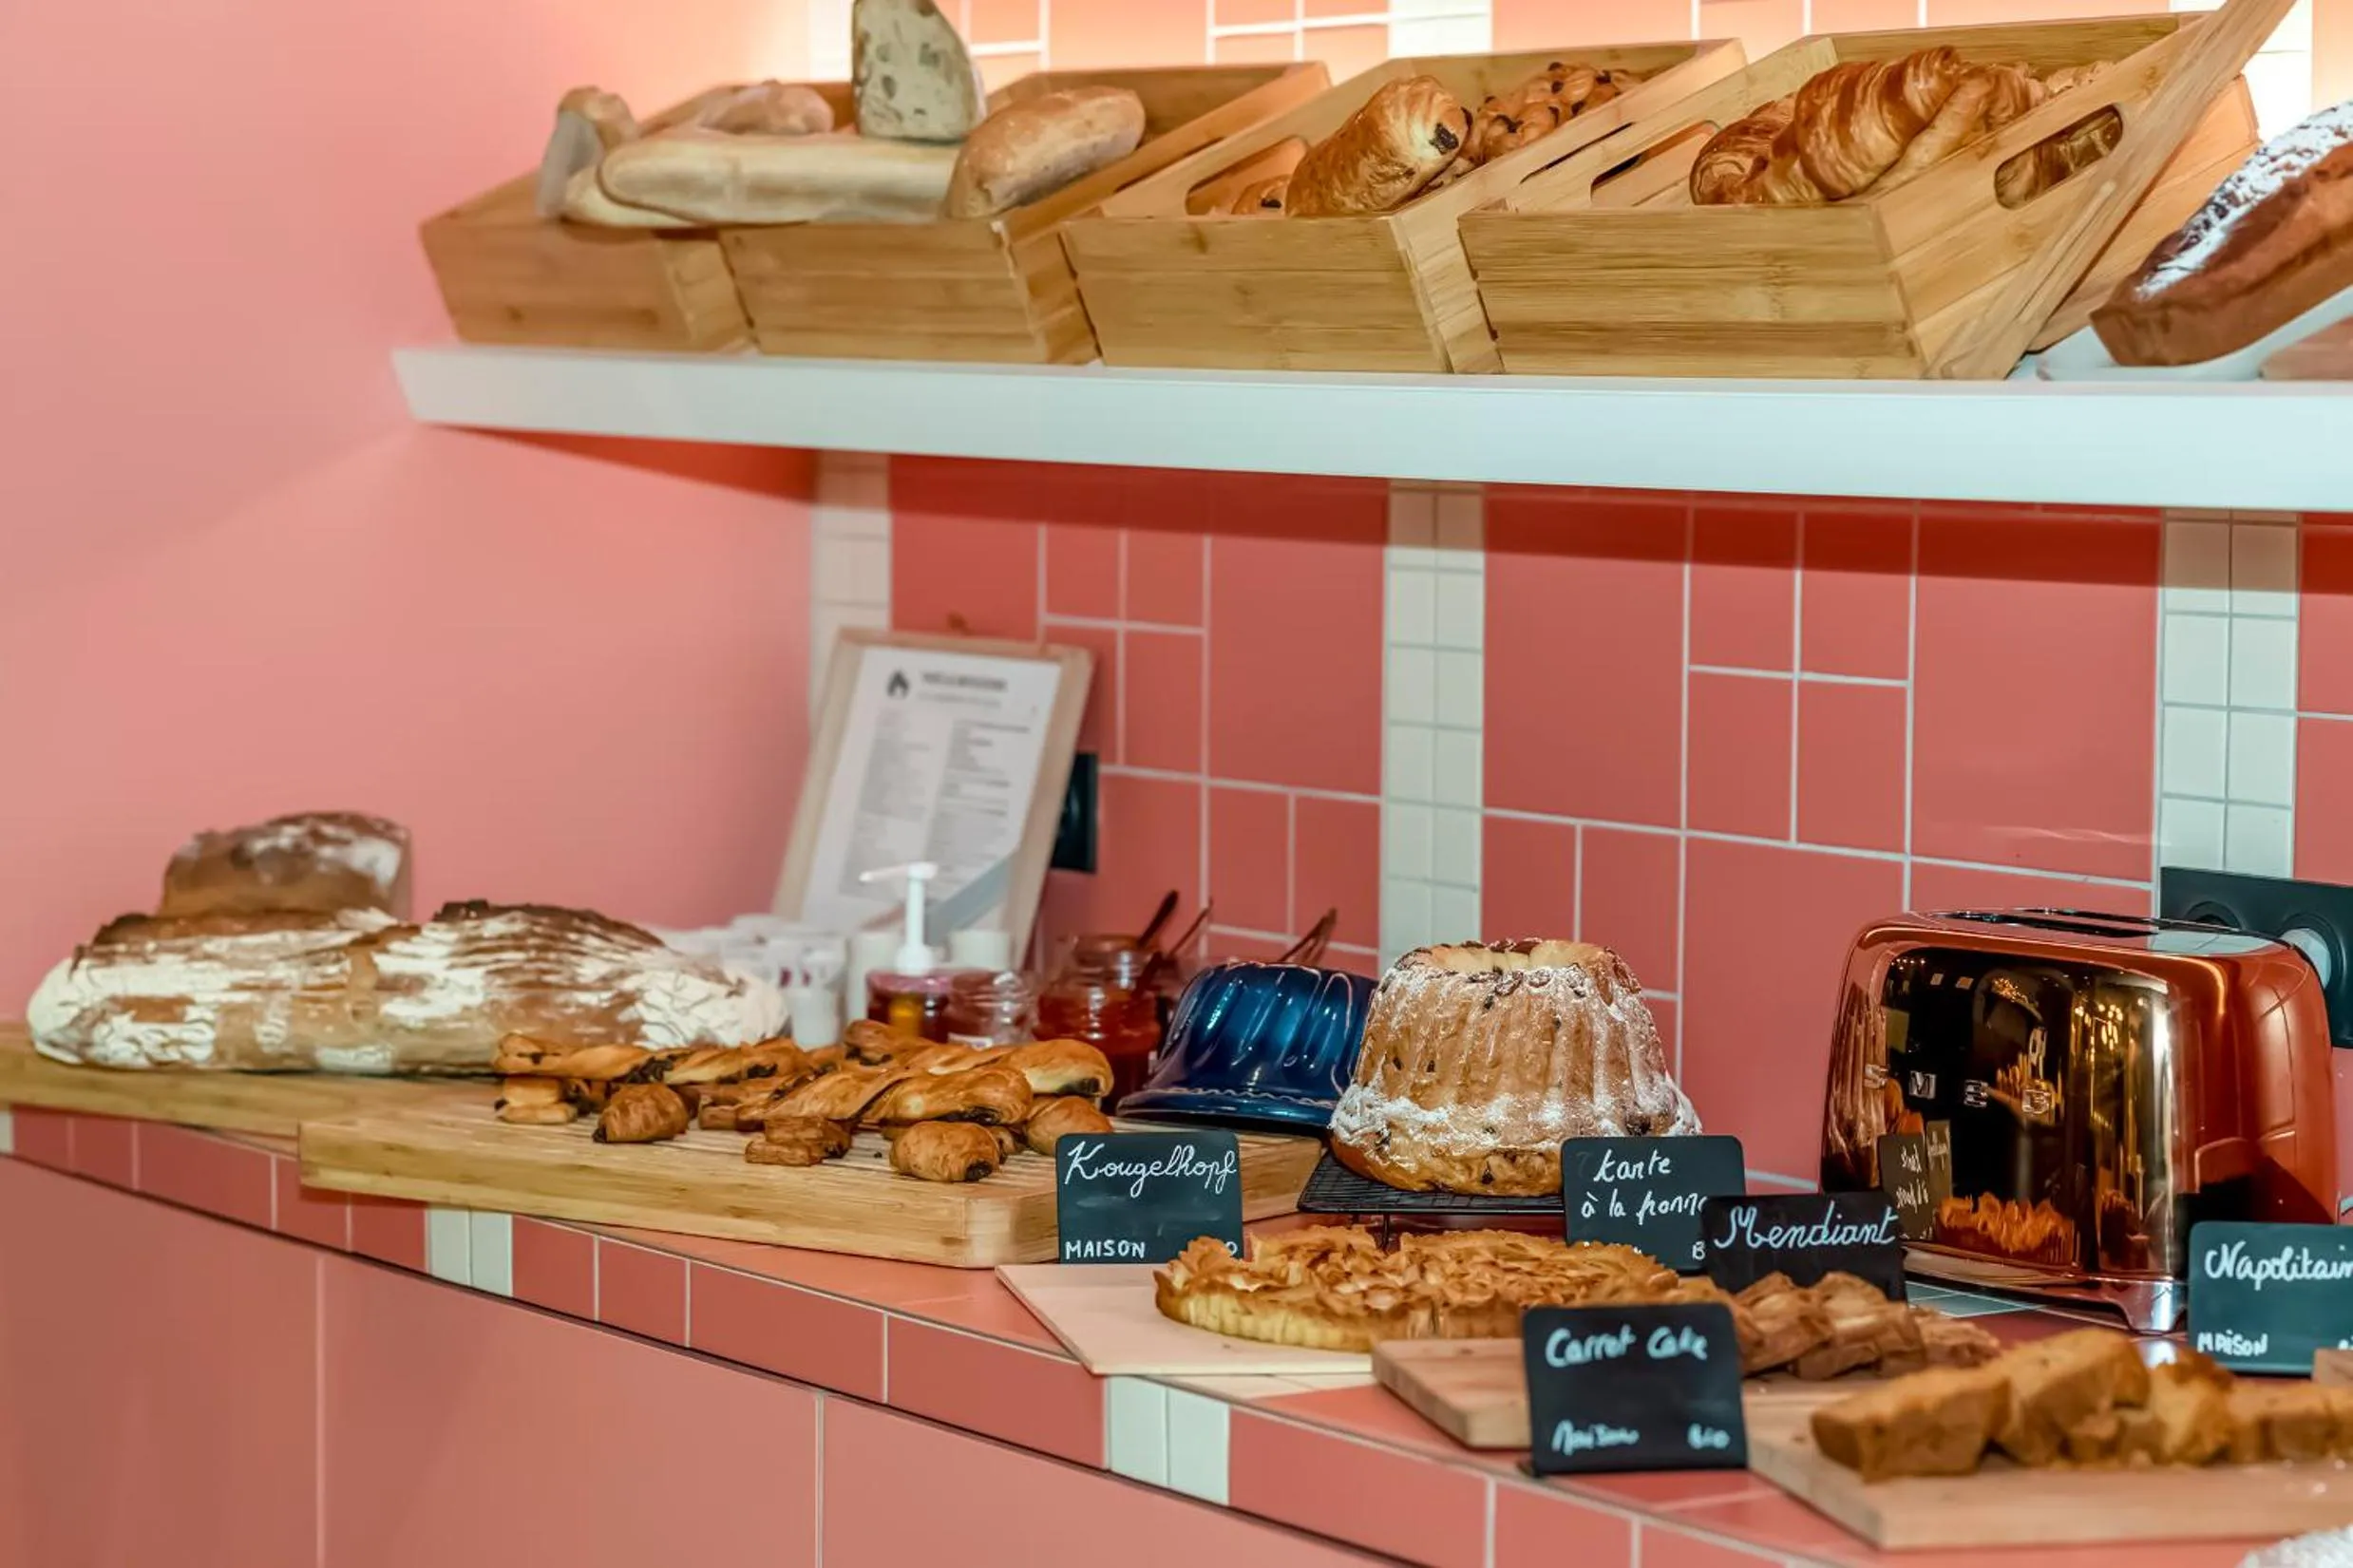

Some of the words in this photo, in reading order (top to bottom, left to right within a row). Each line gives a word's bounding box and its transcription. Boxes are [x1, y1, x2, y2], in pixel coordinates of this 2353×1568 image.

[1581, 1191, 1599, 1219] à
[1608, 1188, 1626, 1218] la
[1714, 1200, 1899, 1249] Mendiant
[1065, 1238, 1146, 1259] MAISON
[1545, 1324, 1637, 1368] Carrot
[1646, 1325, 1708, 1360] Cake
